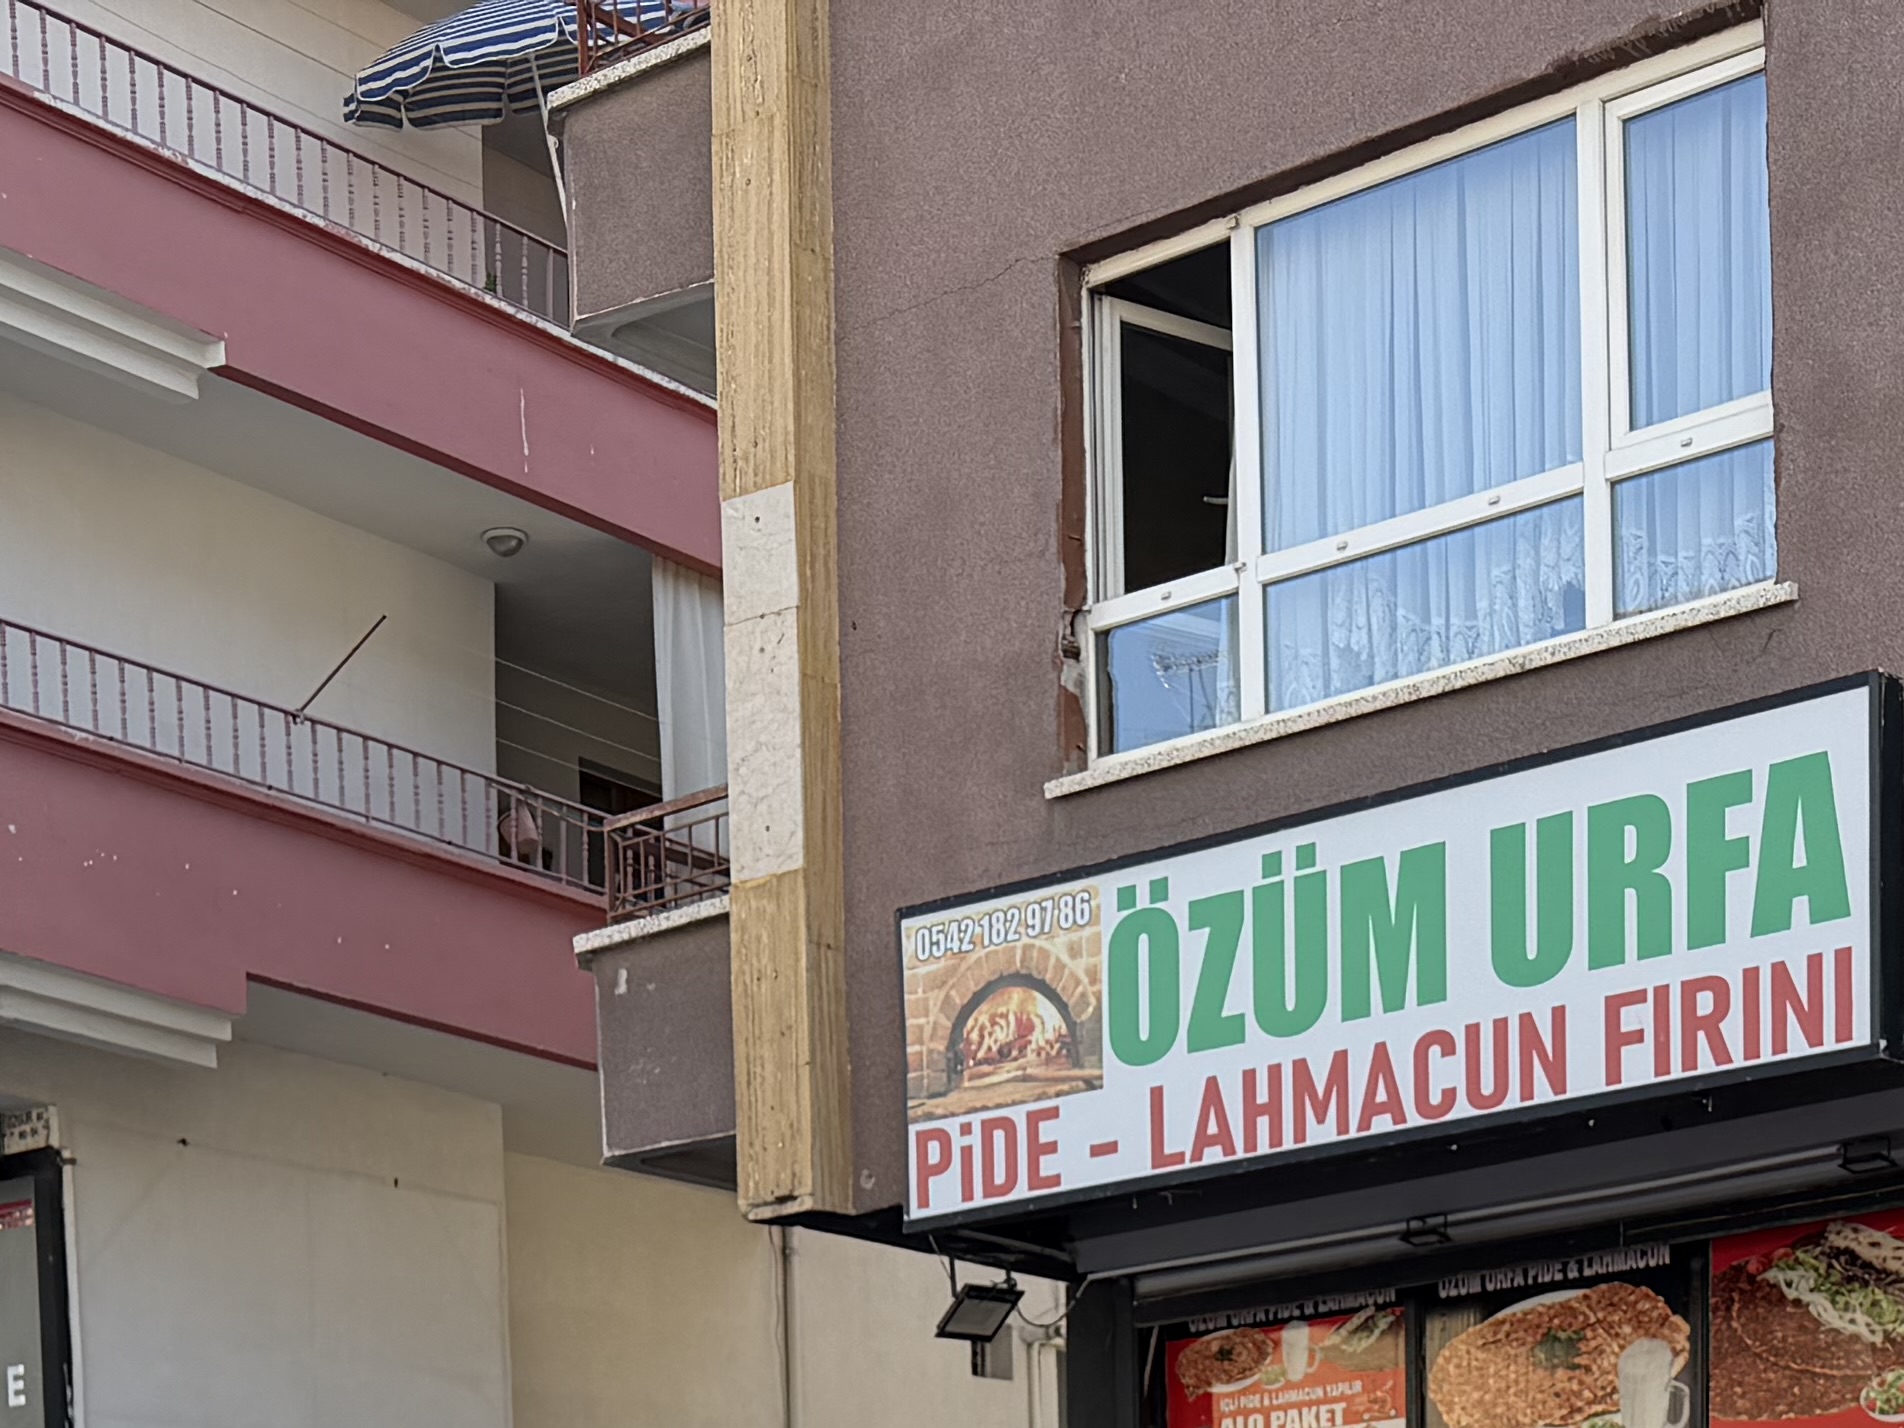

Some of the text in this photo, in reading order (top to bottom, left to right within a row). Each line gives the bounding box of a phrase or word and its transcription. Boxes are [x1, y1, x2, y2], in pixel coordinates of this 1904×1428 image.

[916, 891, 1091, 961] 0542 182 97 86
[1106, 749, 1851, 1068] ÖZÜM URFA
[1089, 1138, 1119, 1158] -
[1148, 1003, 1569, 1170] LAHMACUN
[1604, 946, 1856, 1088] FIRINI
